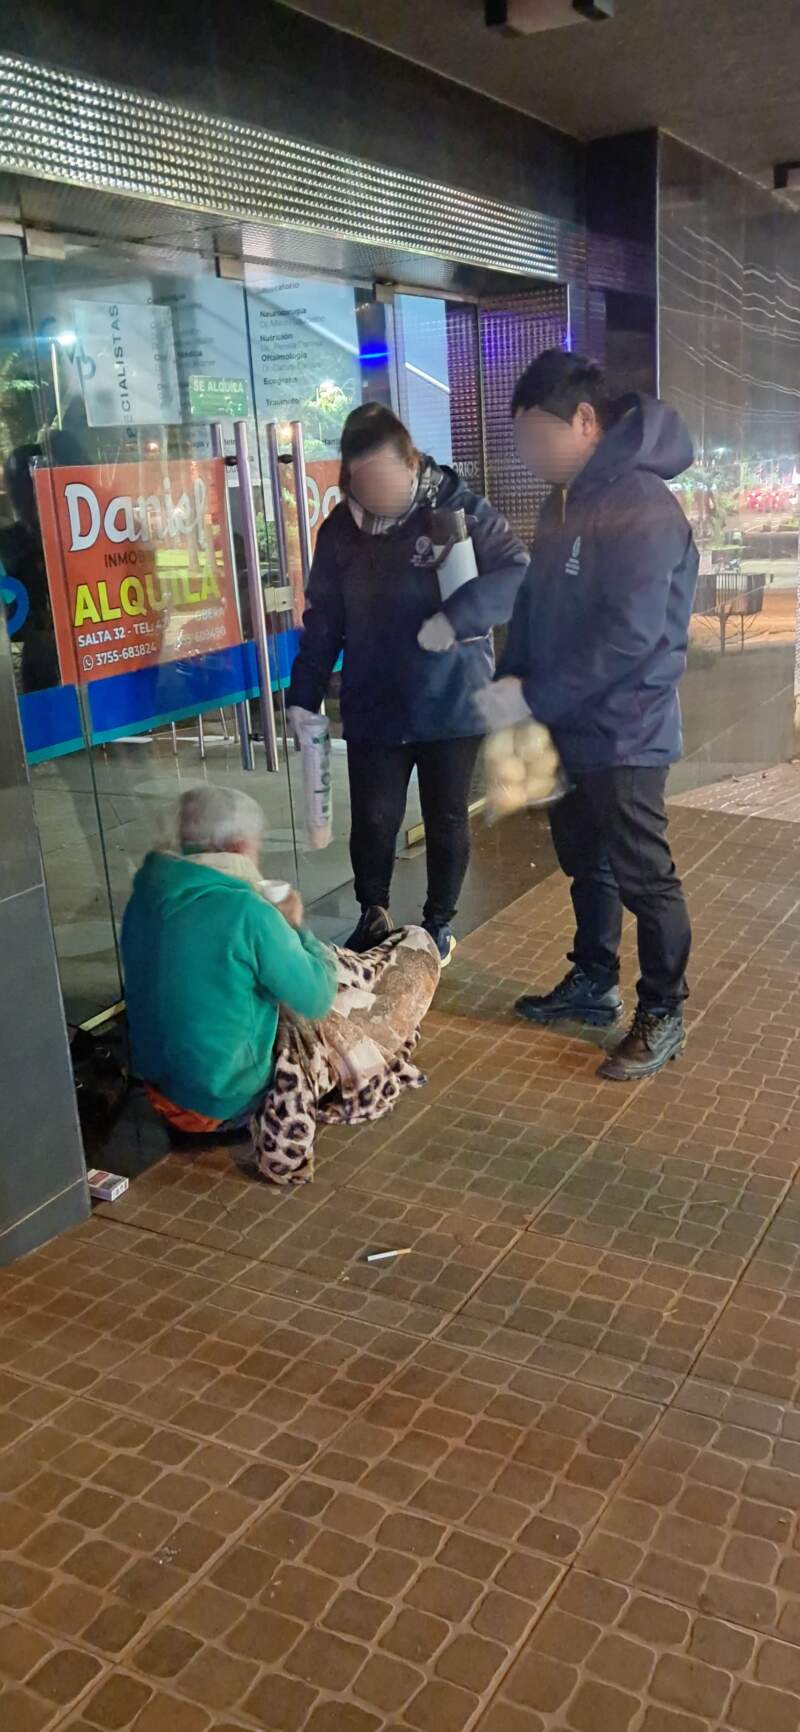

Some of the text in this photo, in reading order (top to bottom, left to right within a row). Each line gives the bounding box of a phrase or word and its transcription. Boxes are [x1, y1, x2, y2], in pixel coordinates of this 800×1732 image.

[193, 379, 245, 394] SE ALQUILA
[64, 475, 206, 552] Daniel
[73, 566, 221, 628] ALQUILA
[78, 629, 112, 648] SALTA
[113, 626, 126, 640] 32
[95, 641, 158, 666] 3755-683824
